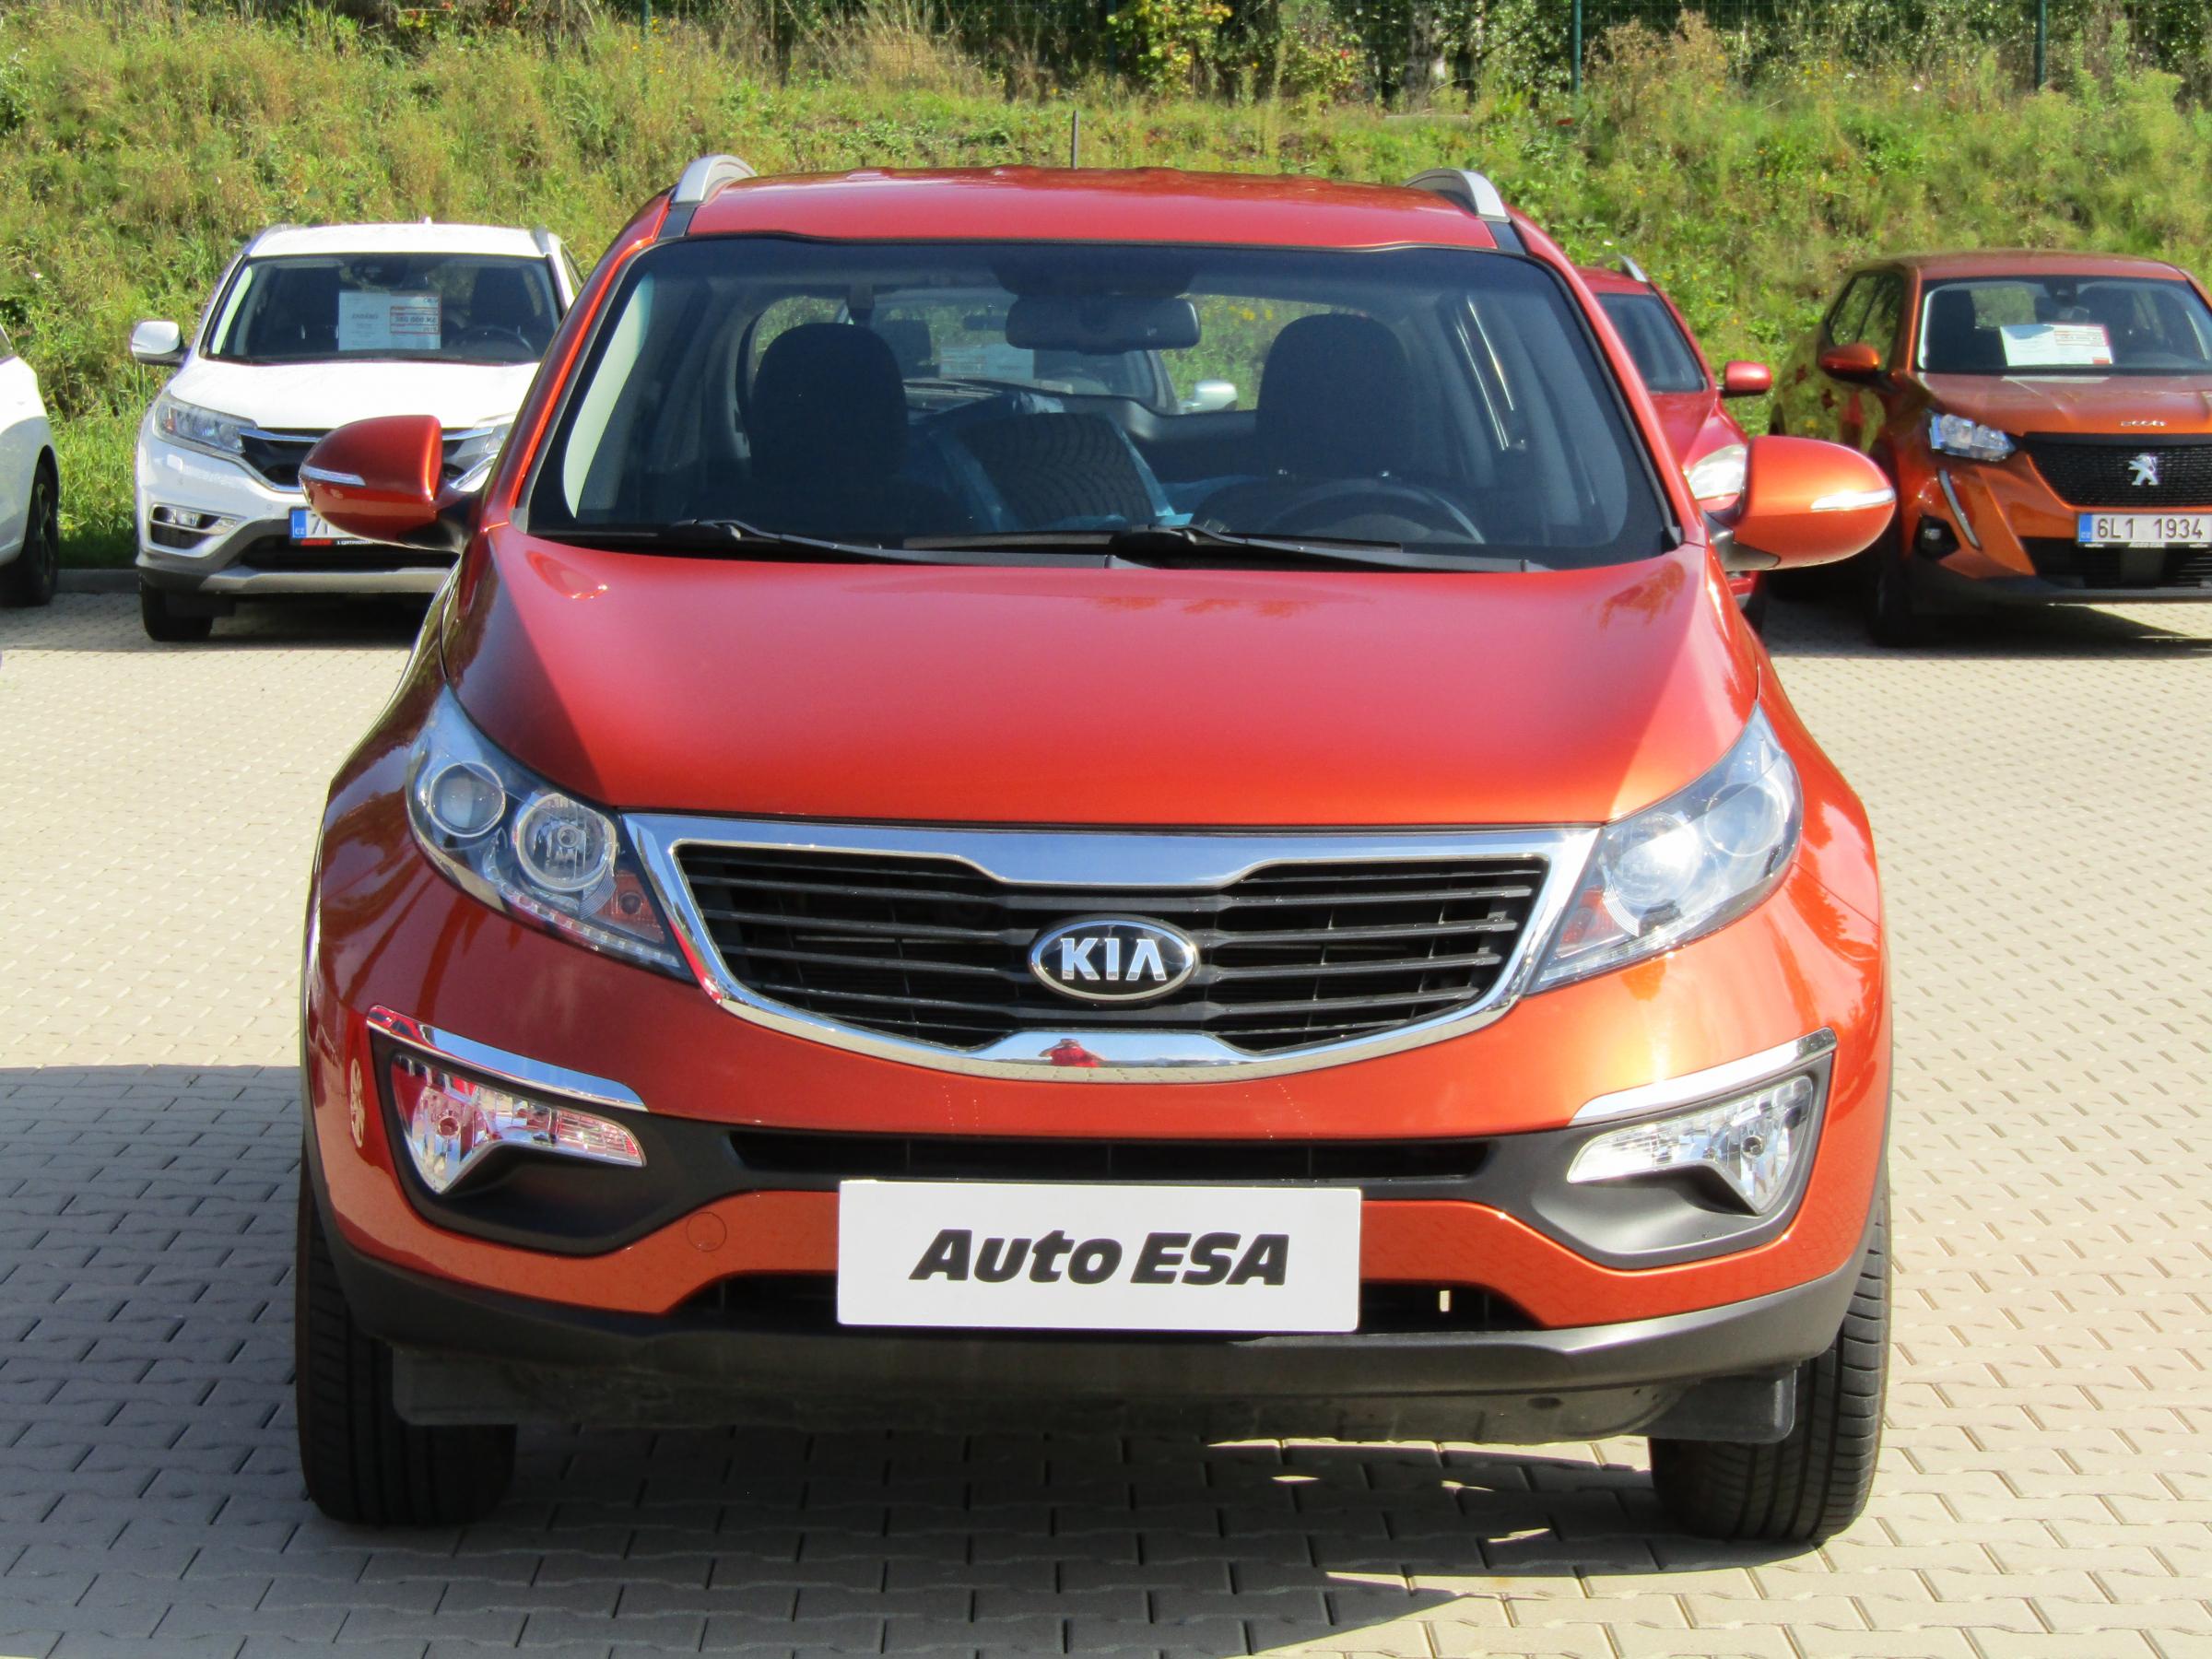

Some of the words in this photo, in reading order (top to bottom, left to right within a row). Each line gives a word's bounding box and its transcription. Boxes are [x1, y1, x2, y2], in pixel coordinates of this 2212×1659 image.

[2098, 518, 2135, 538] 6L1
[2153, 518, 2203, 539] 1934
[1061, 937, 1167, 982] KIA
[908, 1229, 1123, 1285] Auto
[1130, 1231, 1289, 1286] ESA
